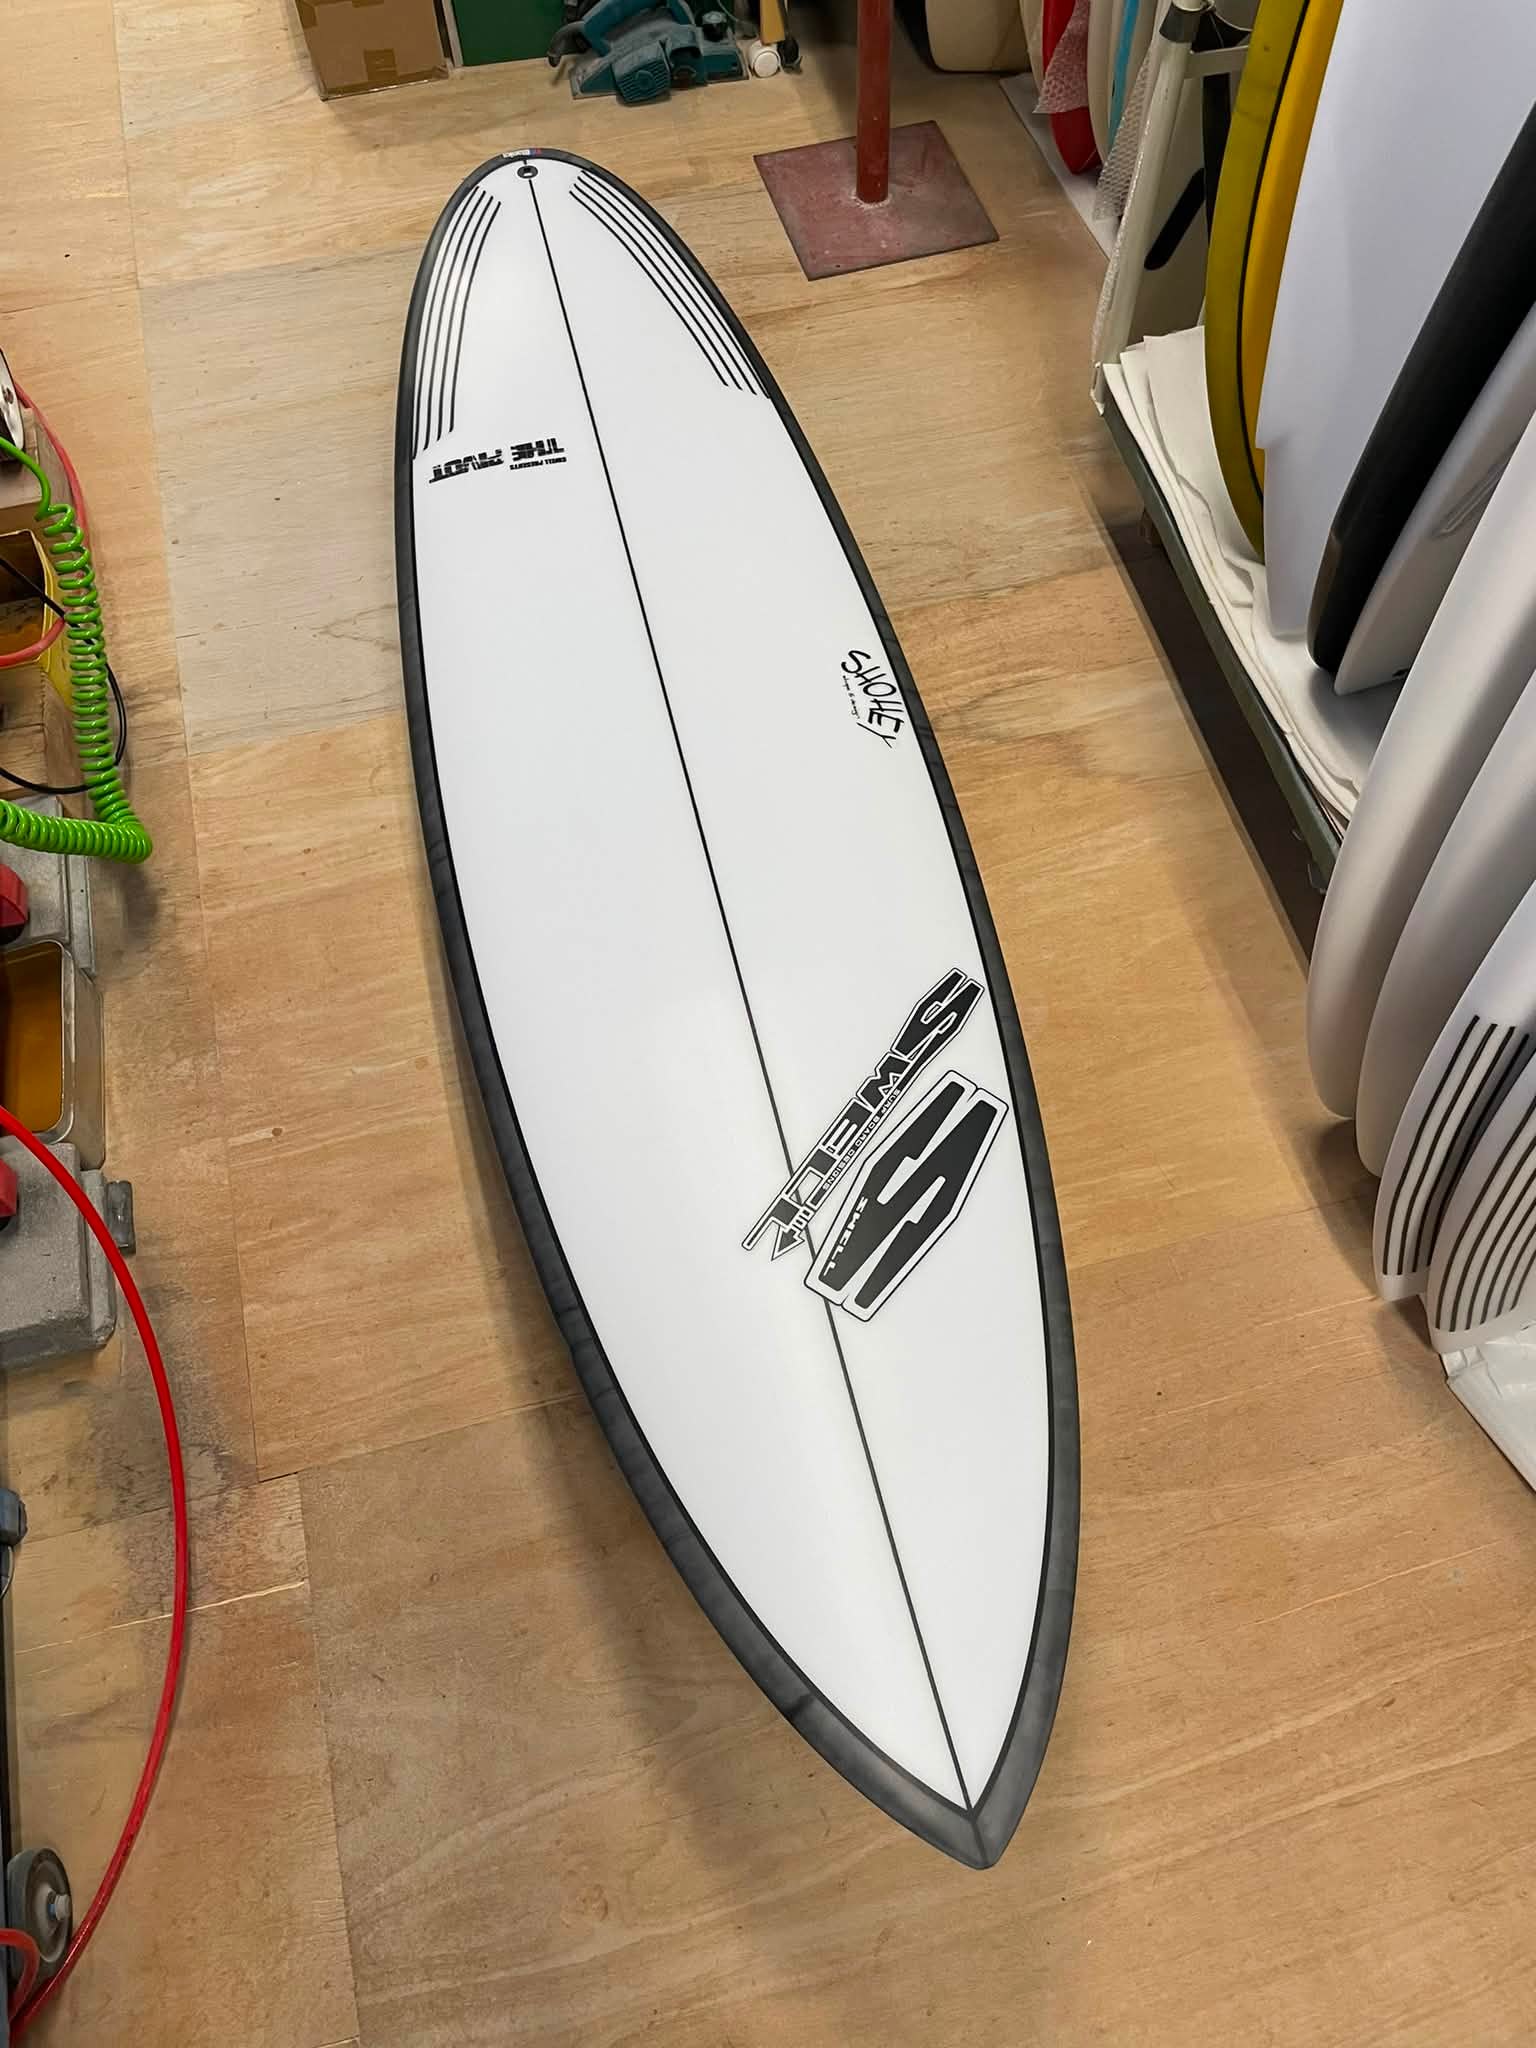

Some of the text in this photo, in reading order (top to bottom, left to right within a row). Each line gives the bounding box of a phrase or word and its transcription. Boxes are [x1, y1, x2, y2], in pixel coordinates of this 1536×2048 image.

[428, 438, 565, 484] THE PIVOT
[840, 649, 905, 749] SHOHEY
[741, 967, 985, 1252] SWELL
[821, 1088, 901, 1191] SURF BOARD DESIGNS
[822, 1196, 869, 1277] SWELL
